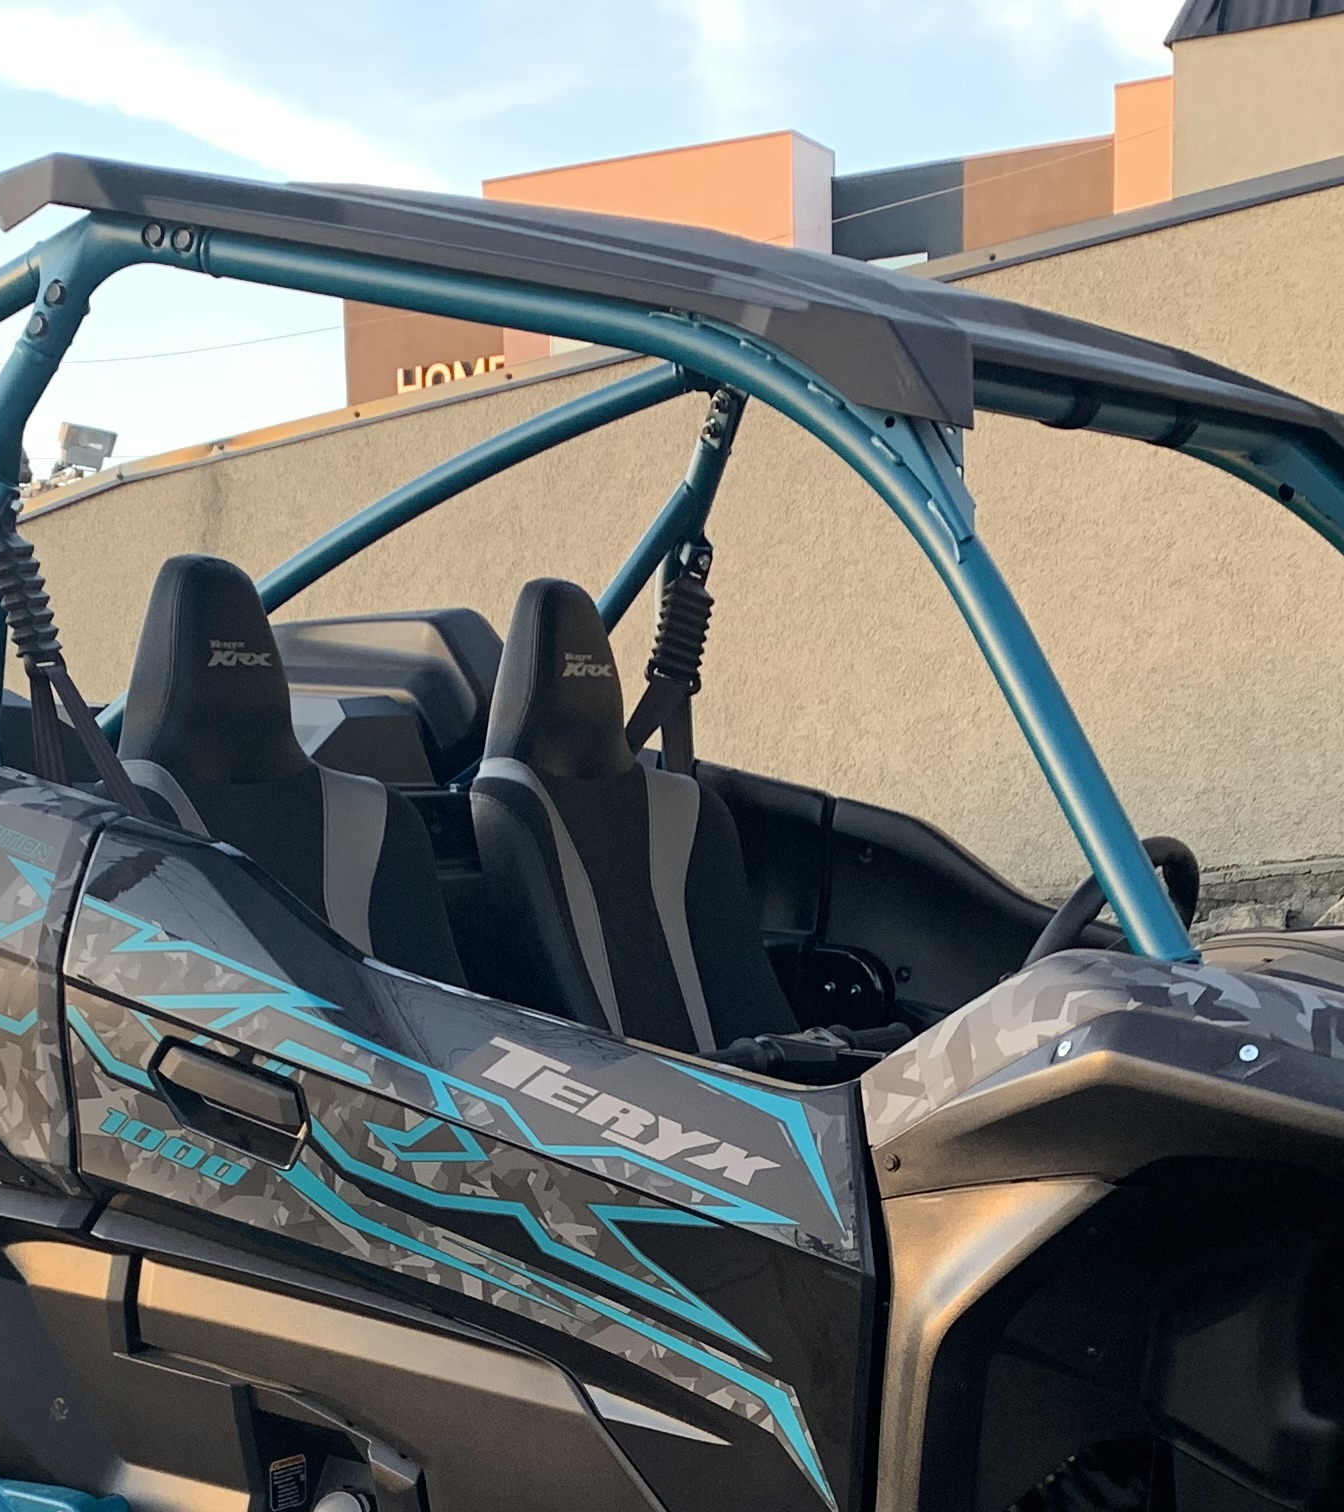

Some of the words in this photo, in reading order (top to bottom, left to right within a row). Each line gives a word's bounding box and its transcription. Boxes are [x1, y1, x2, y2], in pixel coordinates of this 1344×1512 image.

[207, 649, 273, 668] KRX
[561, 661, 613, 678] KRX
[481, 1035, 782, 1186] TERYX
[98, 1106, 249, 1187] 1000
